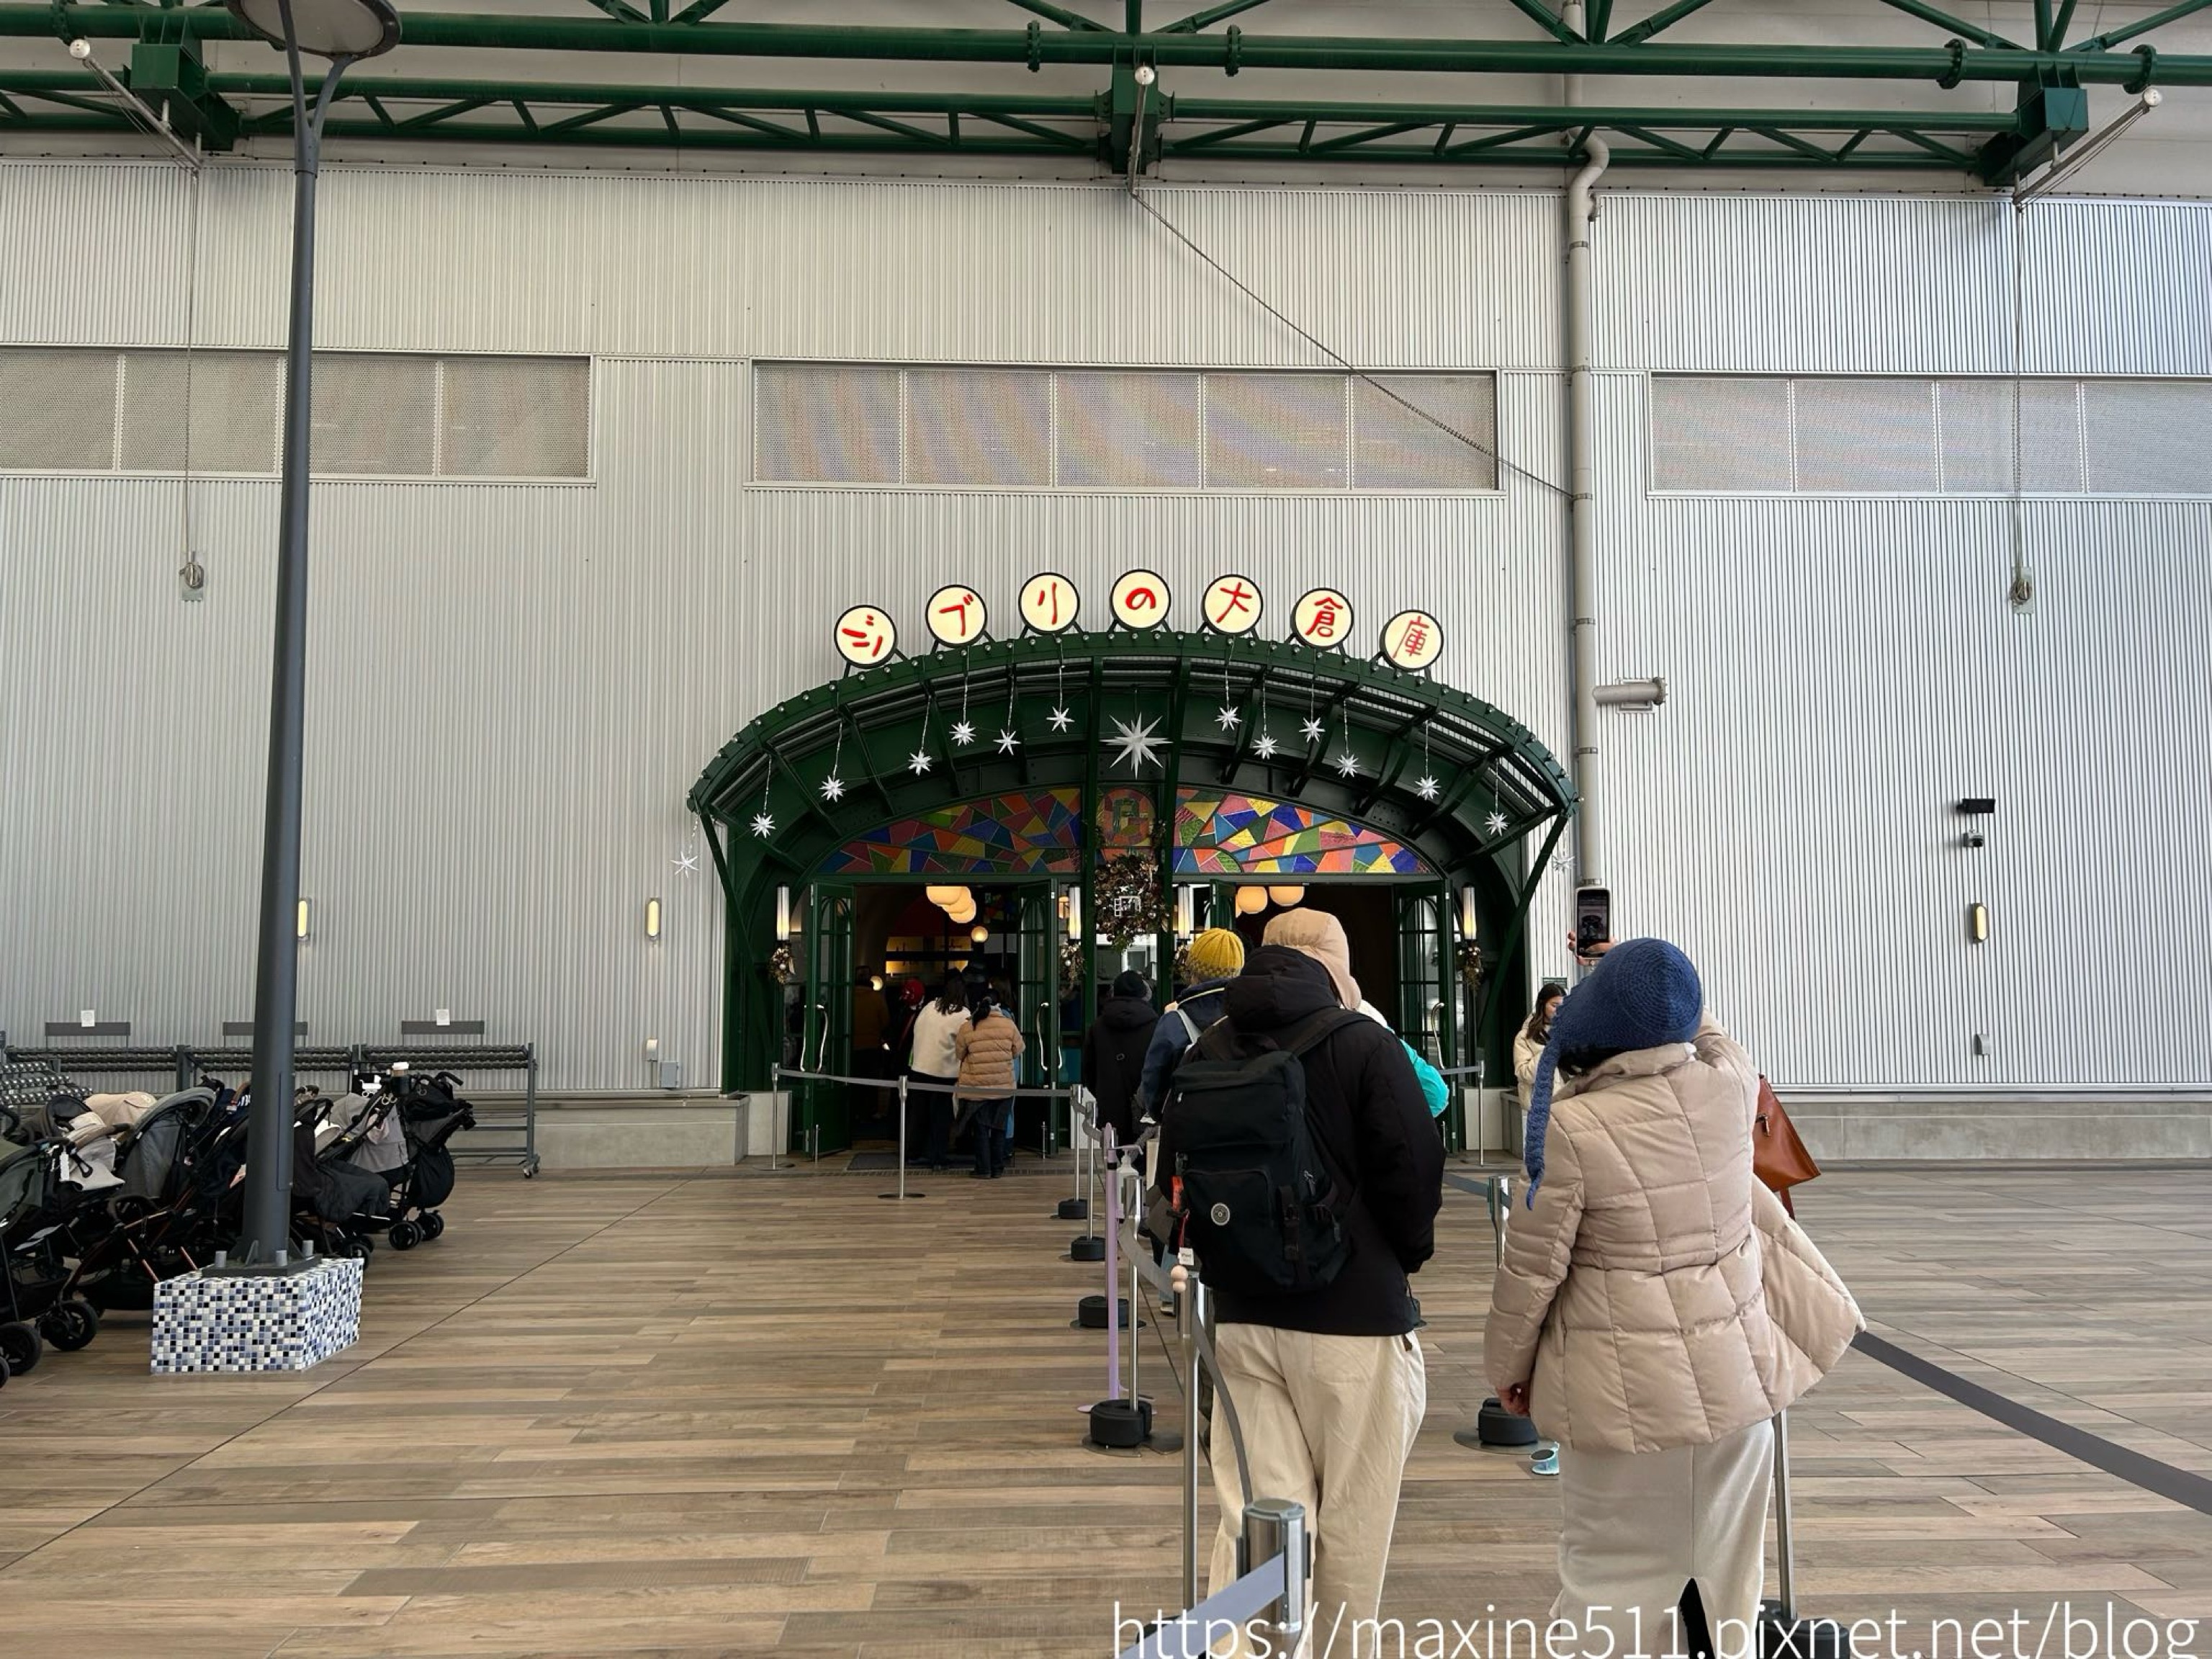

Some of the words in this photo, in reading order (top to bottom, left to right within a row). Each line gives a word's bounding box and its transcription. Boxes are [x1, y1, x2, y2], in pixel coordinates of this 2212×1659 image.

[841, 582, 1430, 659] ジブリの大倉庫
